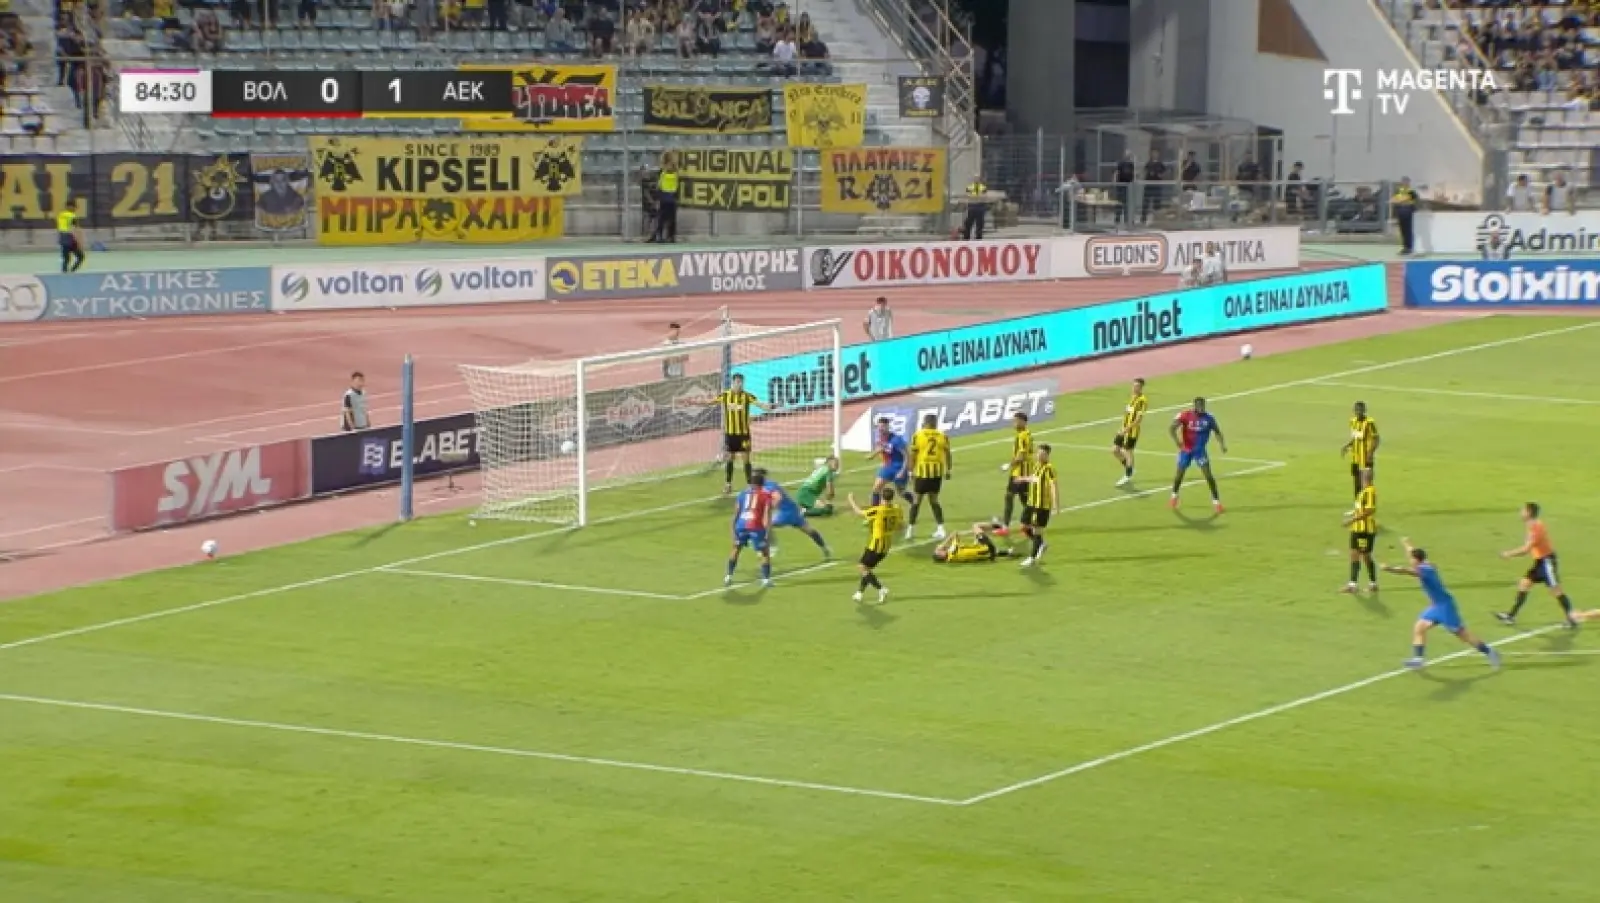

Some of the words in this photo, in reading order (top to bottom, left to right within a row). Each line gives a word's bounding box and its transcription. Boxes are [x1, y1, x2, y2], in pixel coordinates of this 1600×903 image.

[404, 143, 460, 156] SINCE
[376, 156, 519, 192] KIPSELI
[111, 161, 178, 218] 21
[680, 179, 789, 210] LEX/POLI
[678, 248, 799, 277] ΛΥΚΟΥΡΗΣ
[853, 242, 1041, 282] ΟΙΚΟΝΟΜΟΥ
[1093, 244, 1160, 266] ELDON'S
[100, 270, 220, 292] ΑΣΤΙΚΕΣ
[317, 271, 404, 295] volton
[450, 266, 533, 290] volton
[711, 275, 767, 292] ΒΟΛΟΣ
[53, 290, 266, 317] ΣΥΓΚΟΙΝΩΝΙΕΣ
[1224, 295, 1254, 318] ΟΛΑ
[1255, 289, 1294, 314] ΕΙΝΑΙ
[1295, 280, 1350, 309] ΔΥΝΑΤΑ
[1092, 300, 1183, 351] novibet
[917, 343, 949, 372] ΟΛΑ
[951, 335, 991, 366] ΕΙΝΑΙ
[993, 326, 1048, 359] ΔΥΝΑΤΑ
[390, 427, 486, 469] EABET
[926, 437, 938, 456] 2
[157, 445, 272, 515] SYM
